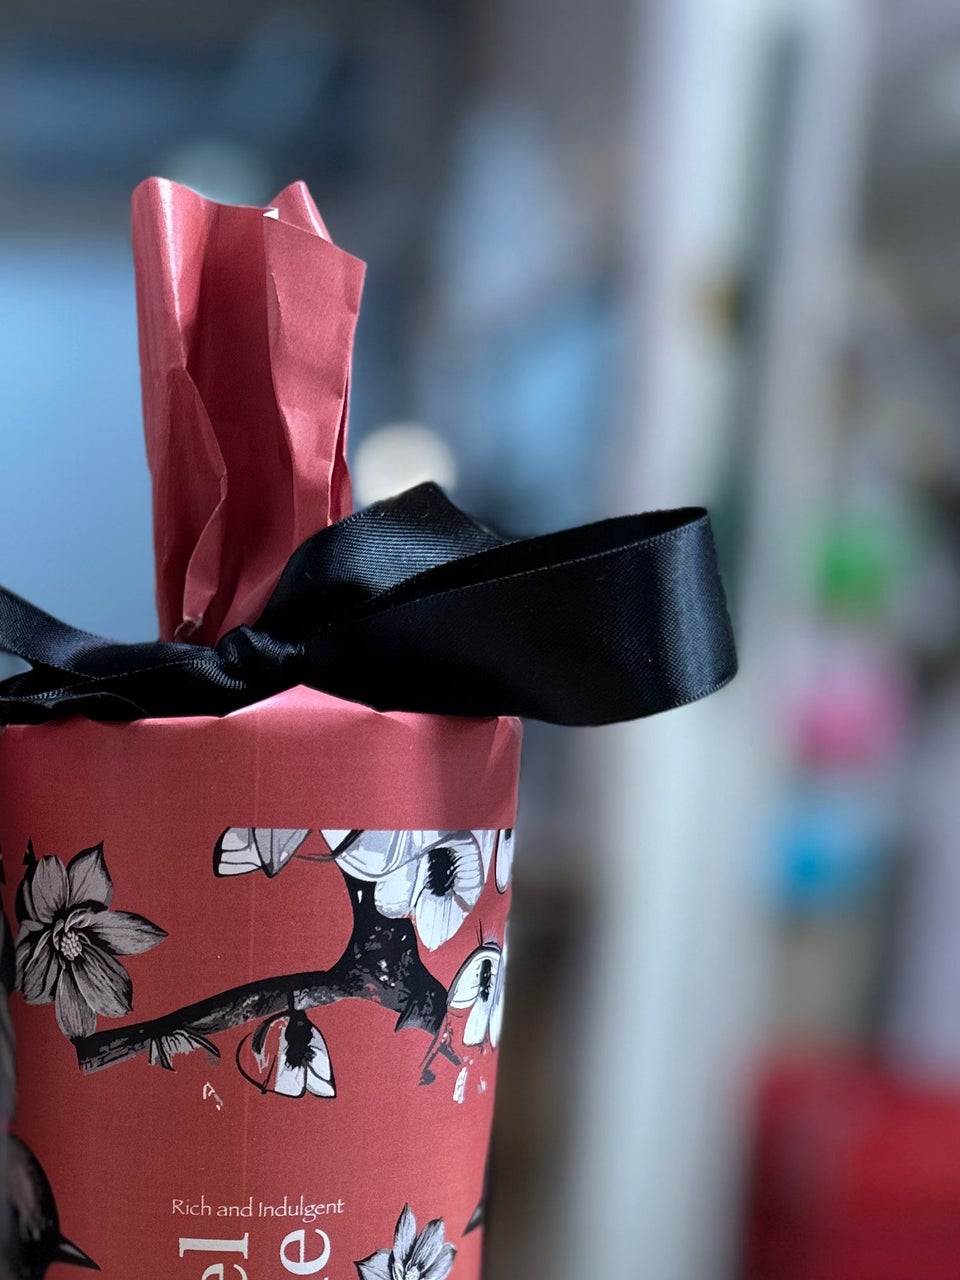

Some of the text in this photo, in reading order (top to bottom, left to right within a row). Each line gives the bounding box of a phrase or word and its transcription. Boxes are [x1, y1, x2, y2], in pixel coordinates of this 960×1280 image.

[172, 1195, 345, 1223] Rich and Indulgent
